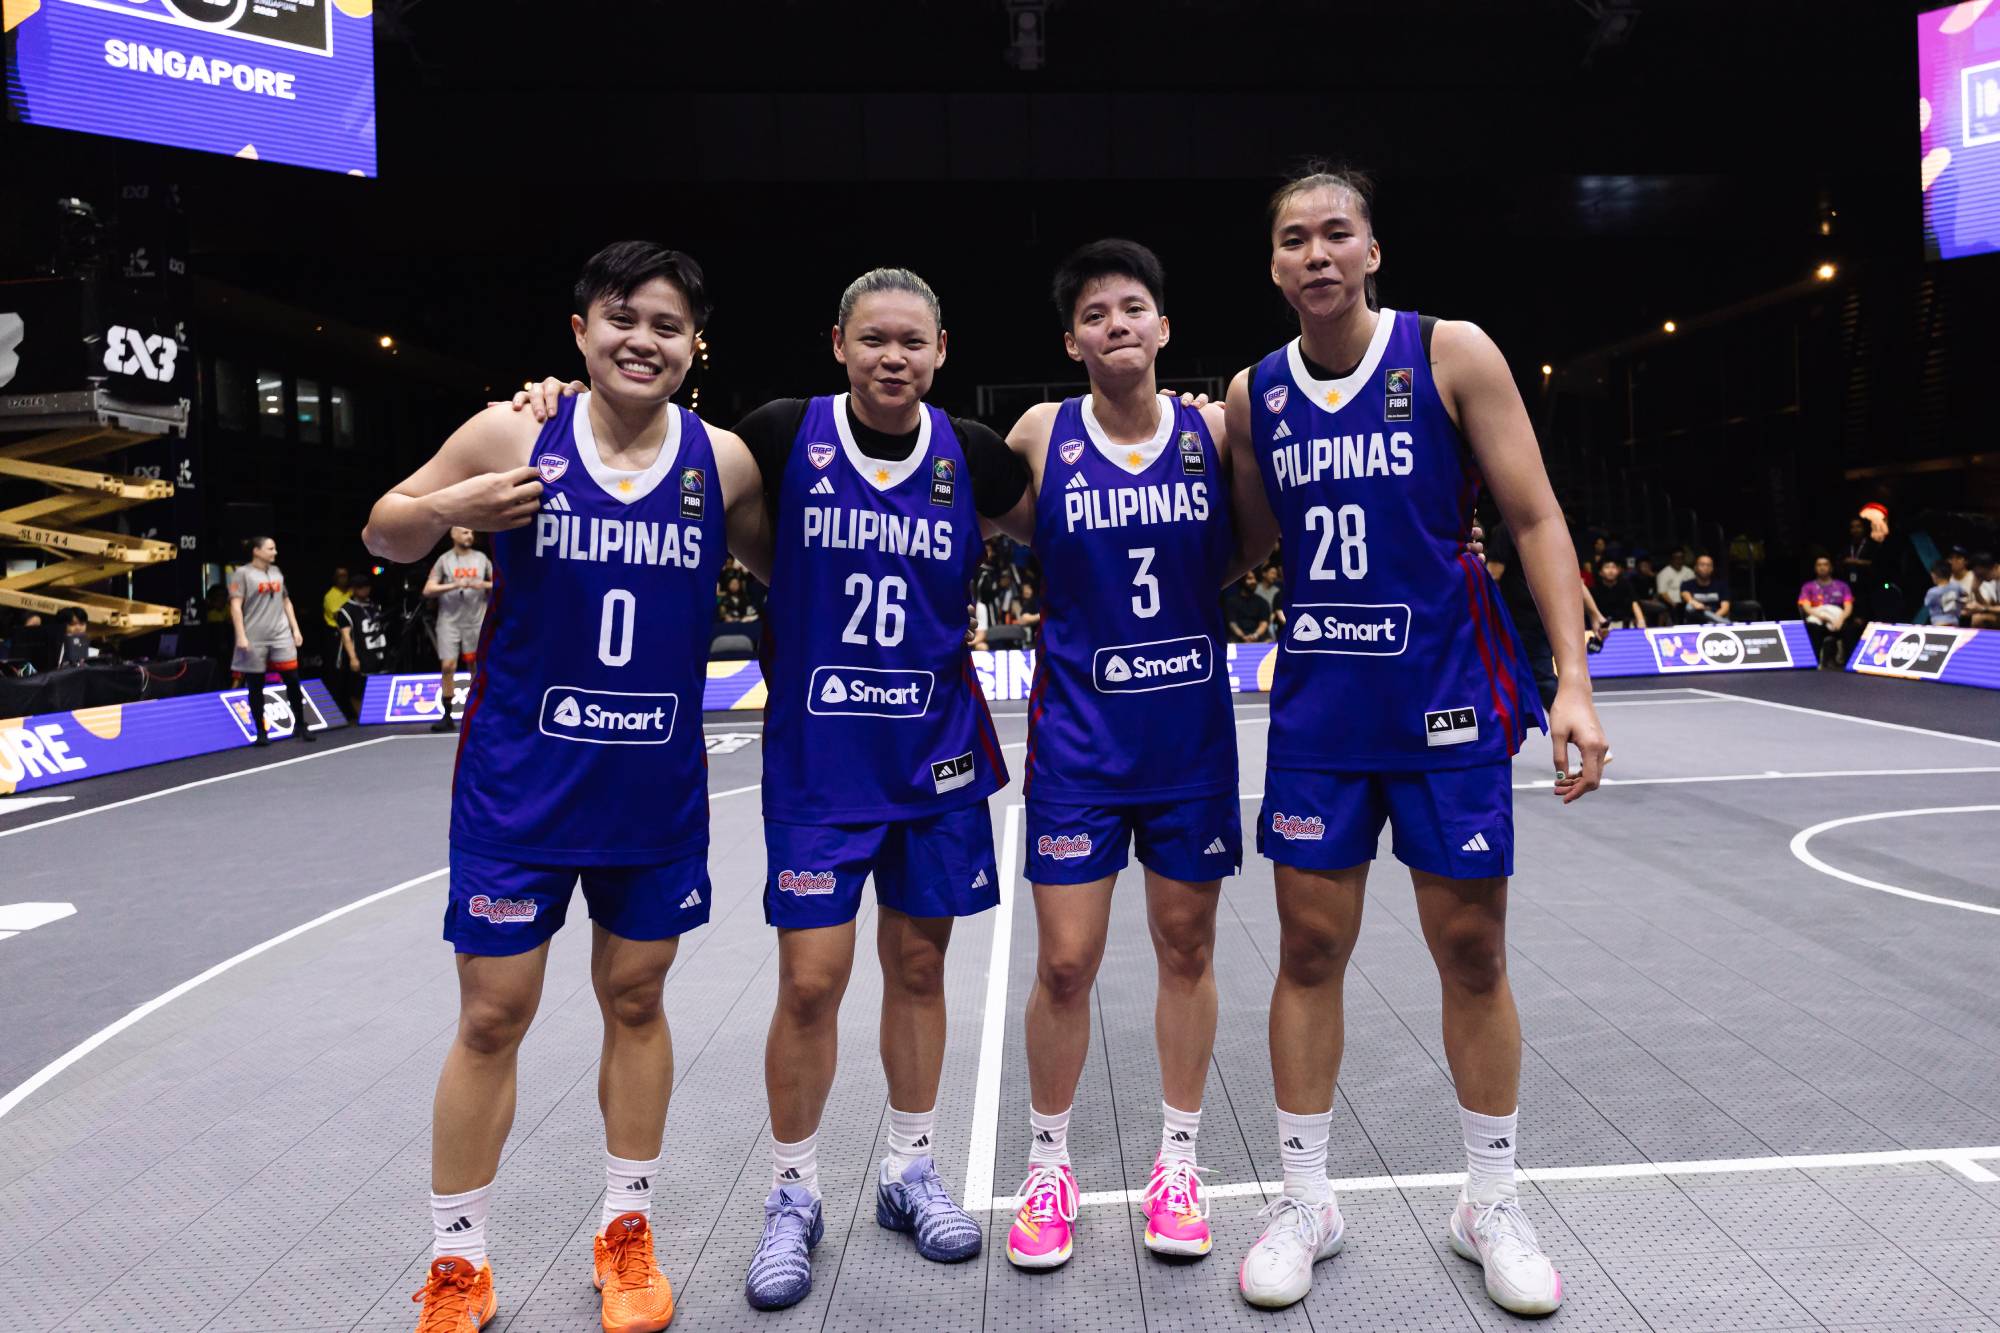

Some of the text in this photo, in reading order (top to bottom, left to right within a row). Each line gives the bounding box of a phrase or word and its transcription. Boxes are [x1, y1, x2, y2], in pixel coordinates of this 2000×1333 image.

[104, 38, 296, 100] SINGAPORE
[1389, 398, 1408, 408] FIBA
[1272, 432, 1413, 492] PILIPINAS
[684, 496, 700, 507] FIBA
[935, 484, 951, 494] FIBA
[1065, 481, 1209, 533] PILIPINAS
[535, 512, 703, 569] PILIPINAS
[804, 506, 953, 561] PILIPINAS
[1305, 504, 1368, 580] 28
[842, 573, 907, 646] 26
[1128, 547, 1161, 619] 3
[598, 589, 636, 667] 0
[1324, 616, 1397, 642] Smart
[1132, 649, 1202, 679] Smart
[583, 704, 666, 730] Smart
[850, 679, 920, 705] Smart
